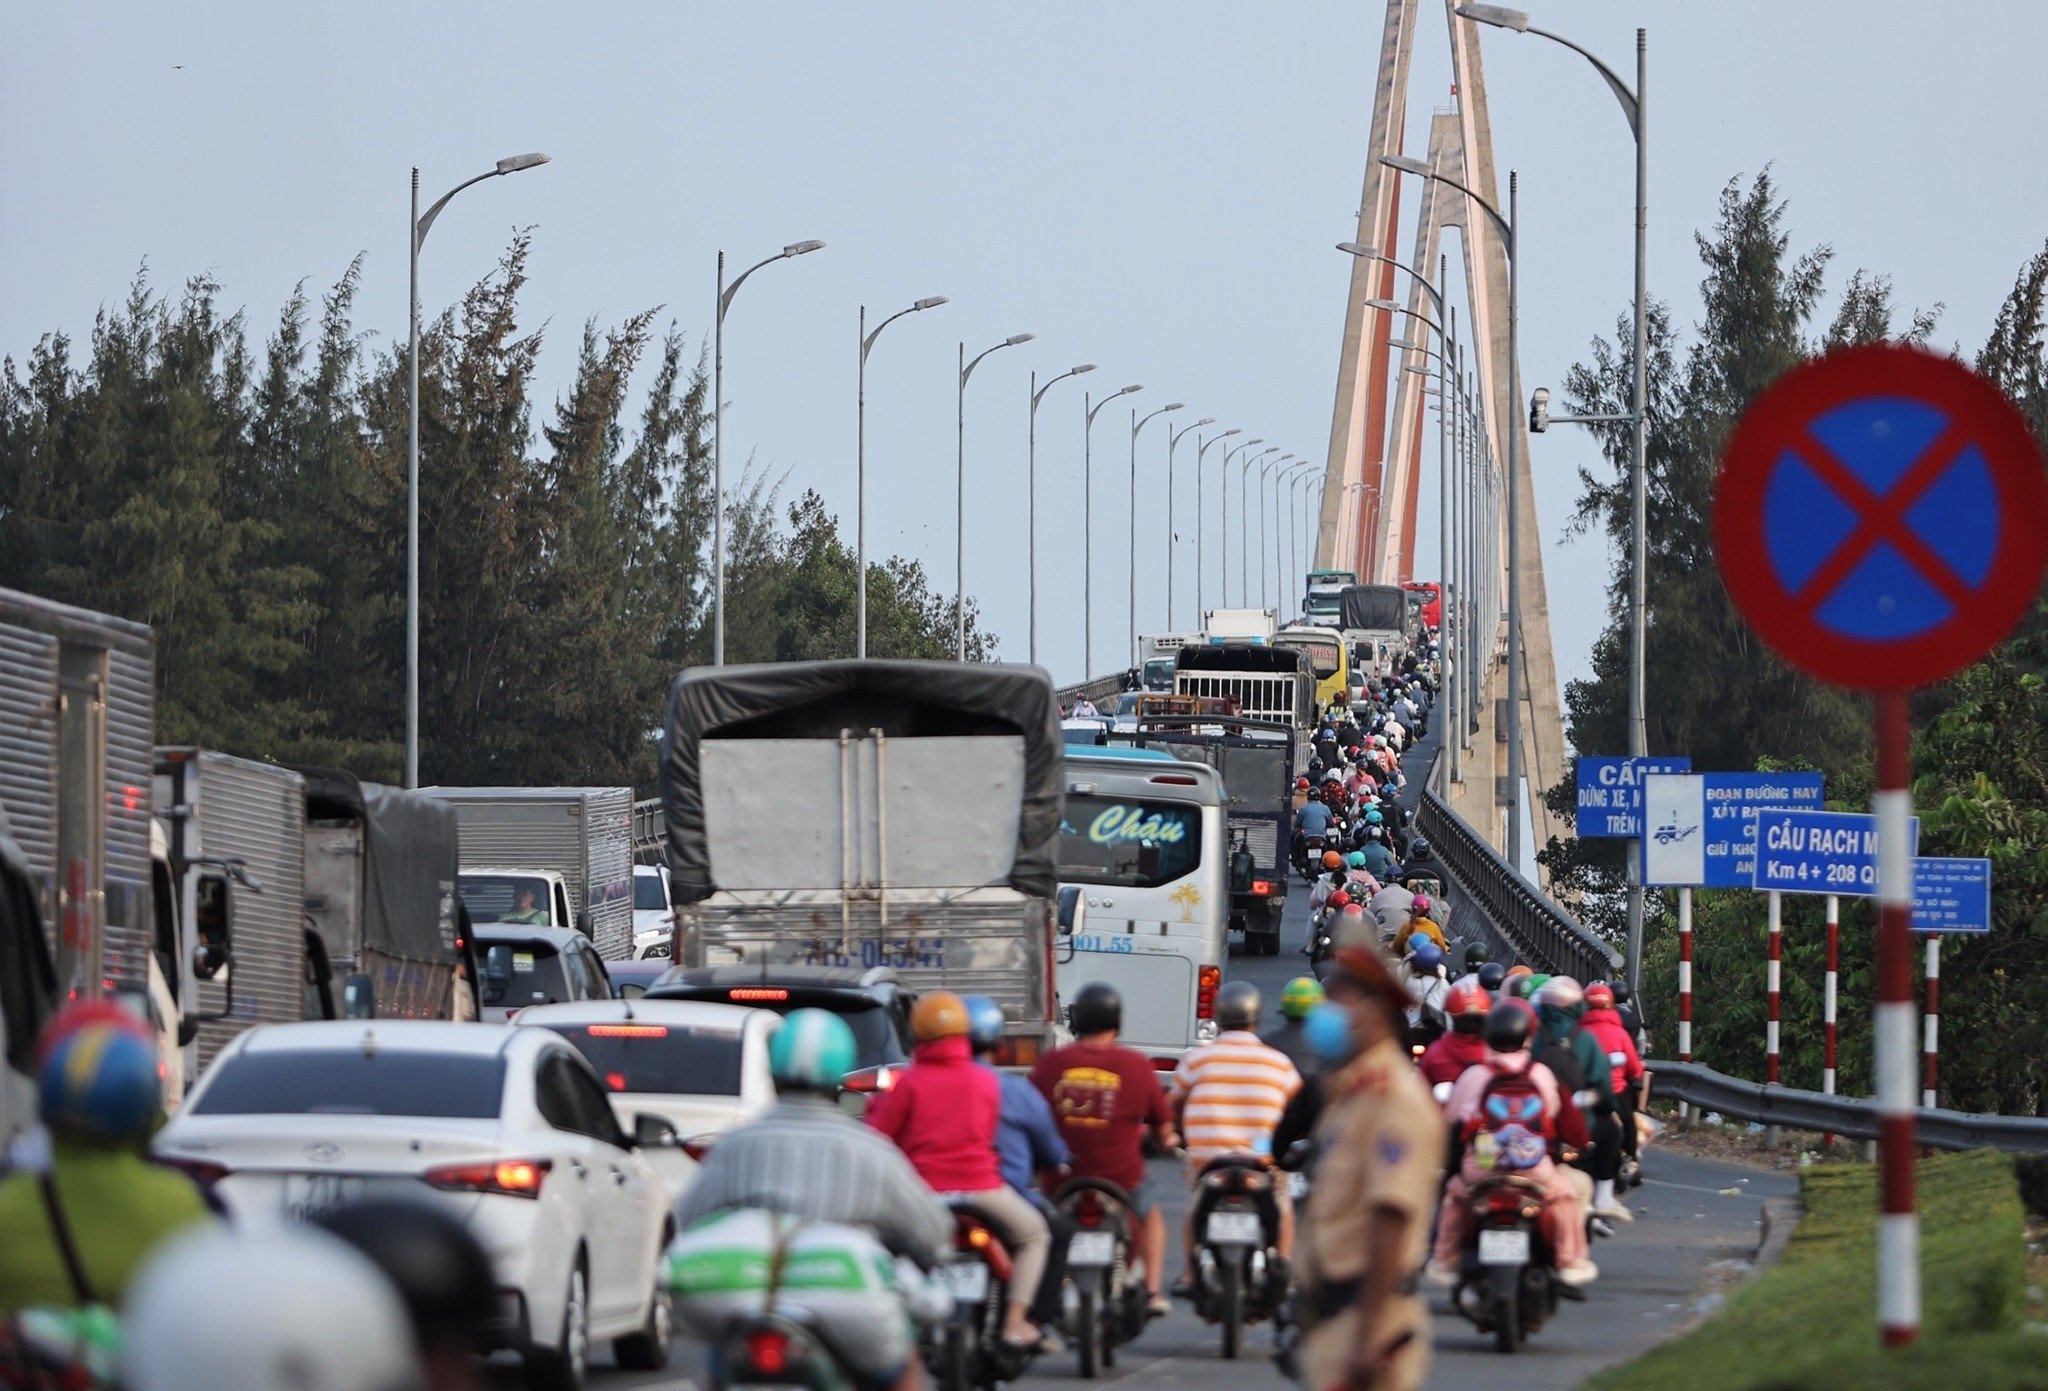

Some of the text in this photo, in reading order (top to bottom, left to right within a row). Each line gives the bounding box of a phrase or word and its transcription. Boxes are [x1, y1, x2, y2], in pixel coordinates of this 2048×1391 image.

[1578, 784, 1607, 807] DỪNG
[1612, 789, 1629, 811] XE,
[1706, 784, 1819, 801] ĐOẠN ĐƯỜNG HAY
[1742, 806, 1759, 818] RA
[1089, 804, 1187, 844] Châu
[1606, 812, 1635, 833] TRÊN
[1768, 818, 1805, 851] CẦU
[1810, 828, 1859, 856] RẠCH
[1706, 840, 1729, 855] GIỮ
[1826, 864, 1856, 882] 208
